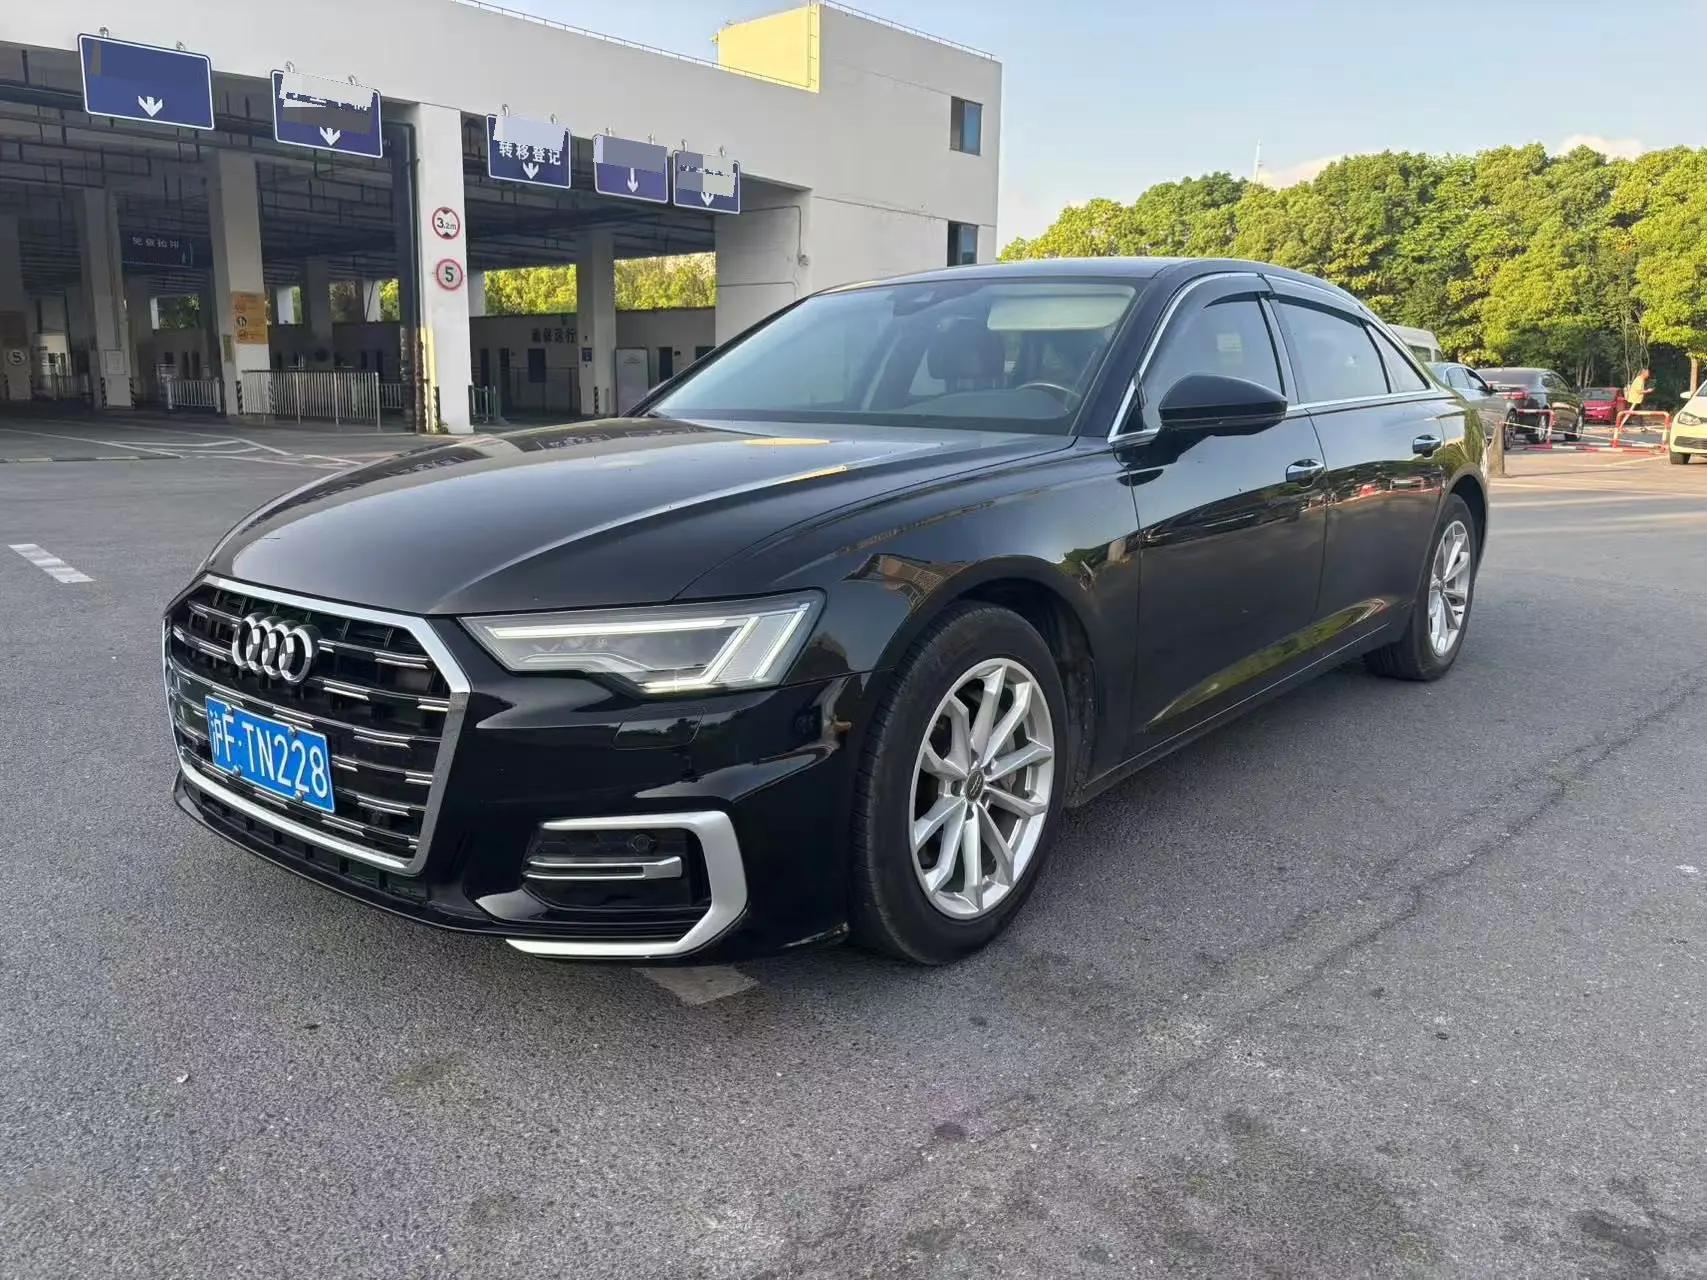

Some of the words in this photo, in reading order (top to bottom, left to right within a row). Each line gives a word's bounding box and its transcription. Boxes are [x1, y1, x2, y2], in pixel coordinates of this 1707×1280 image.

[499, 141, 561, 166] 转移登记
[444, 266, 454, 282] 5
